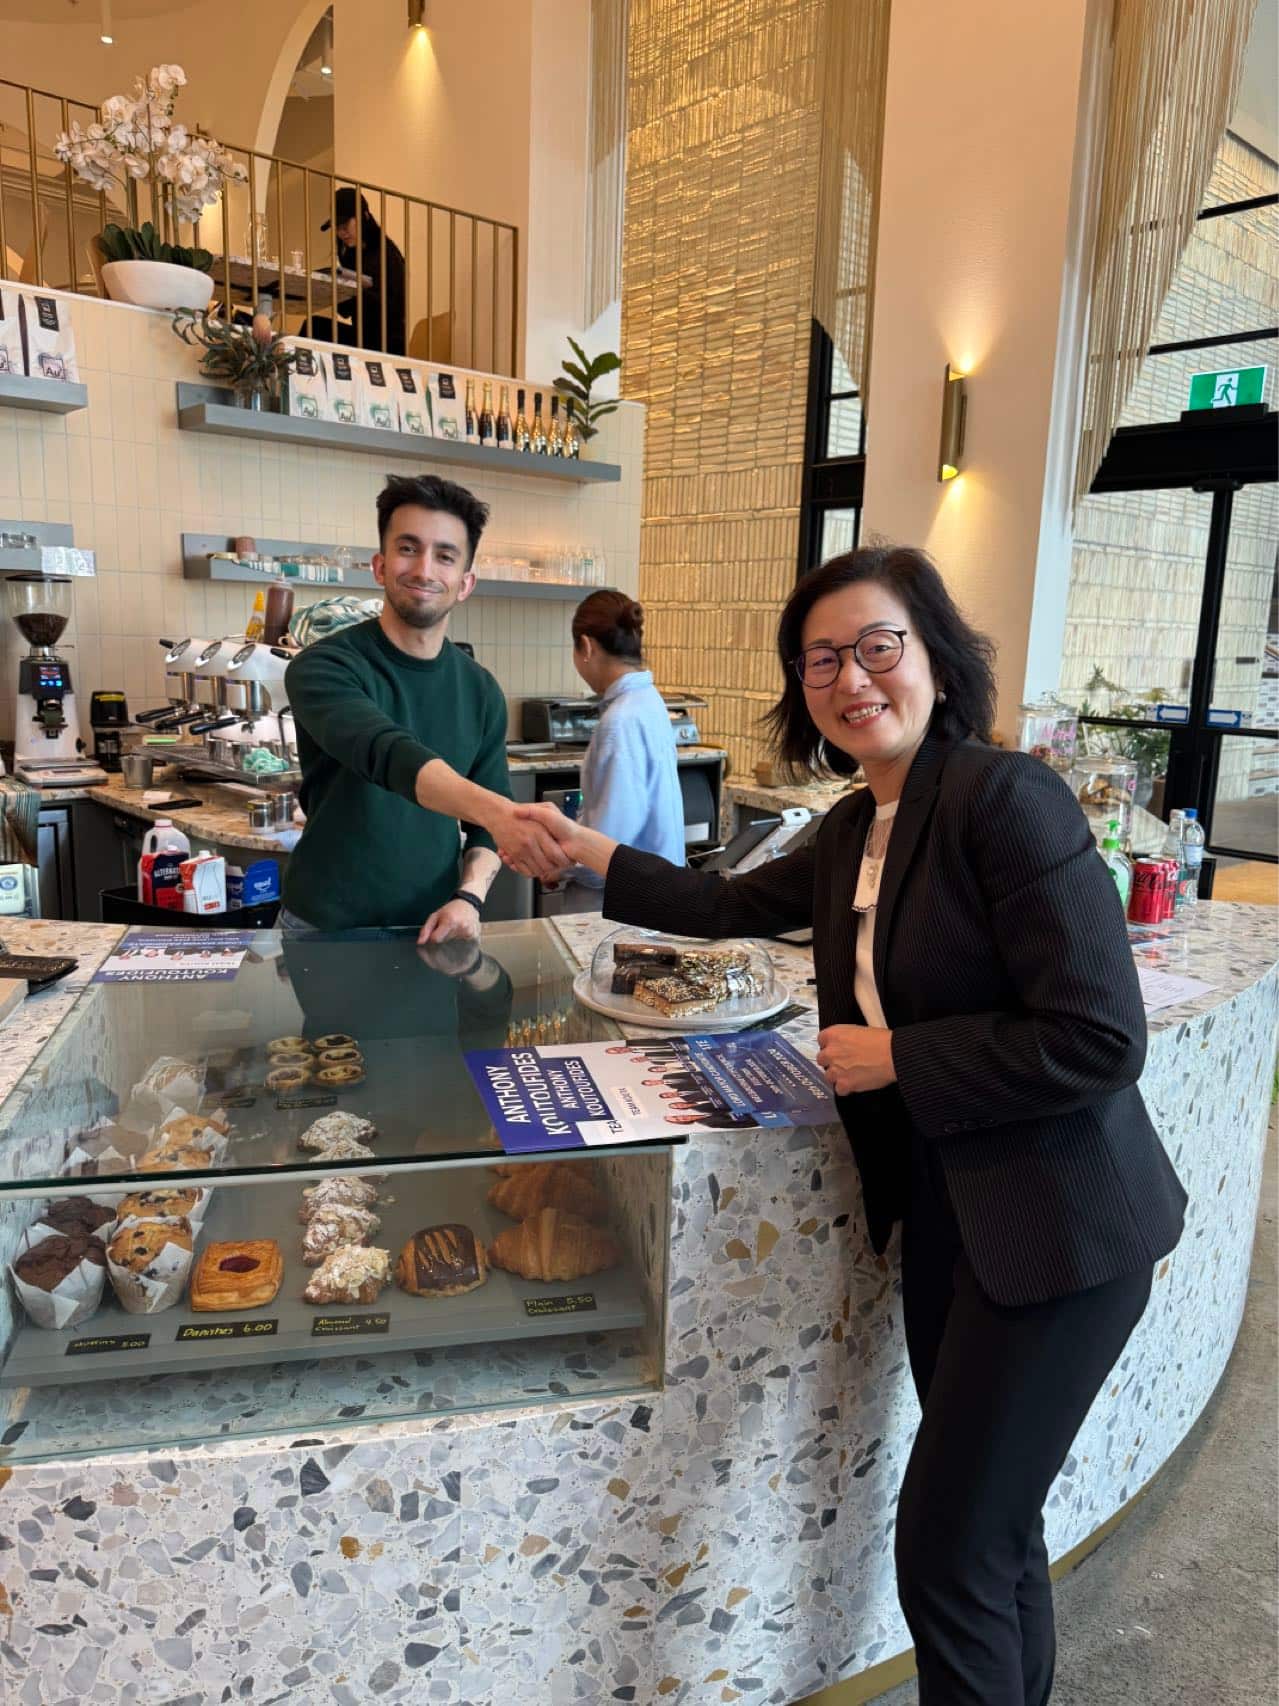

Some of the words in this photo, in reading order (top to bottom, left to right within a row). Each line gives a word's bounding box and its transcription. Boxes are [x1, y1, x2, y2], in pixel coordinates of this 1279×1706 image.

[485, 1065, 532, 1123] ANTHONY
[511, 1052, 572, 1135] KOUTOUFIDES
[546, 1069, 580, 1109] ANTHONY
[564, 1060, 607, 1117] KOUTOUFIDES
